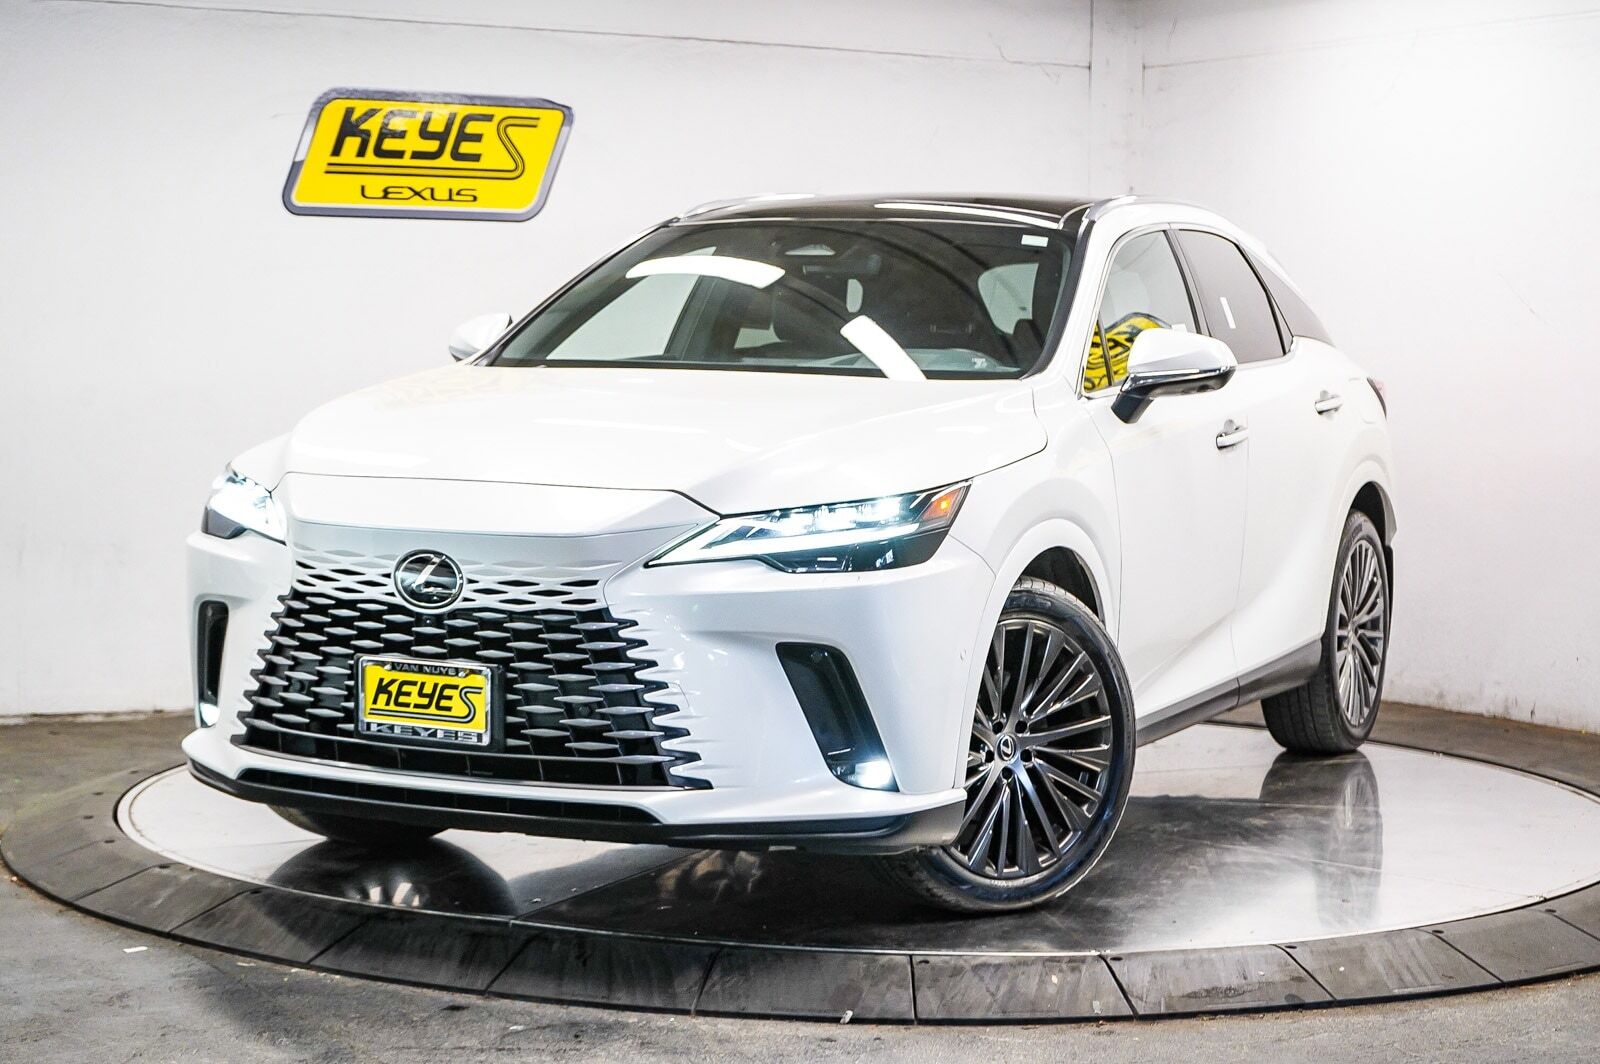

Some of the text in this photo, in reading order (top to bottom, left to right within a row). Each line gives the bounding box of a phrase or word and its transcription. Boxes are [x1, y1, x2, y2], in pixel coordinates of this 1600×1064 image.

[326, 106, 541, 180] KEYES
[361, 185, 478, 202] LEXUS
[394, 663, 457, 675] VAN NUYS
[368, 677, 483, 723] KEYES
[370, 722, 478, 742] KEYES
